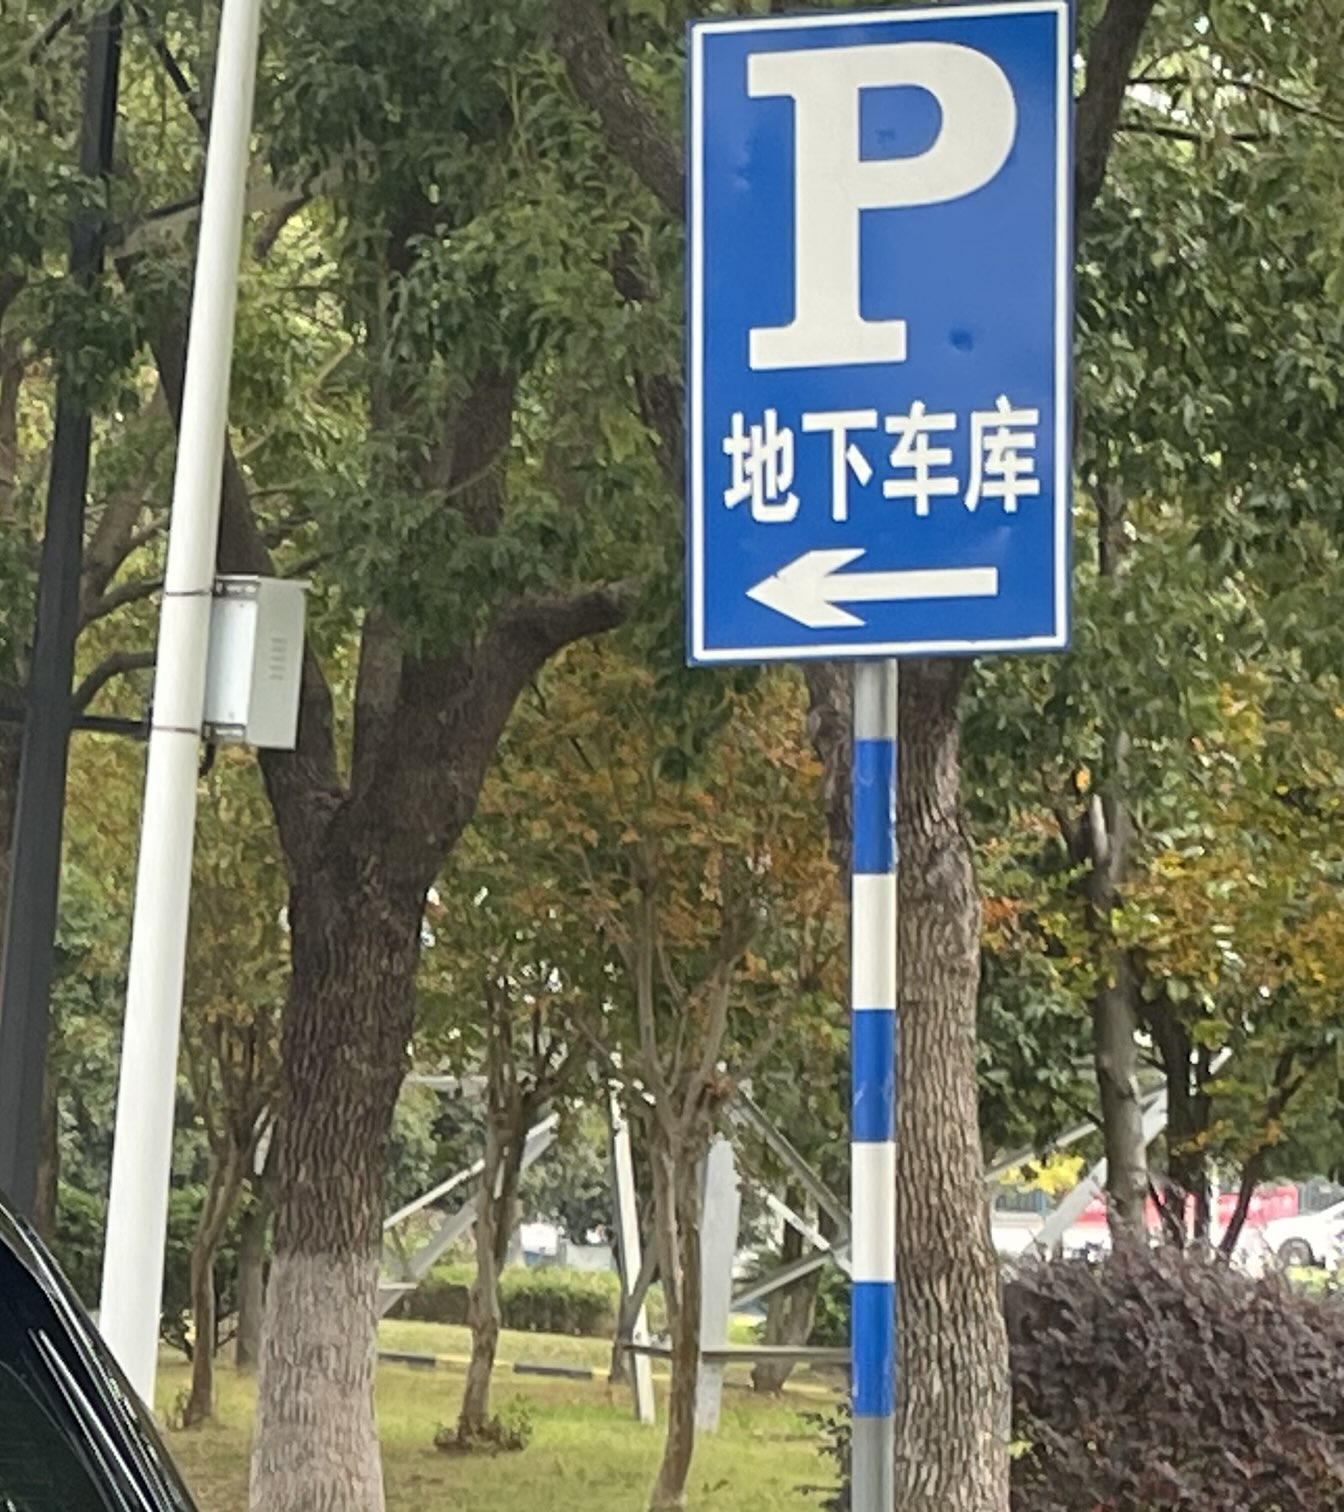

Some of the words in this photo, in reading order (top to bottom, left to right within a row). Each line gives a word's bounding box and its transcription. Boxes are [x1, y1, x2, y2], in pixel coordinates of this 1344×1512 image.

[746, 40, 1018, 371] P
[722, 393, 1041, 524] 地下车库
